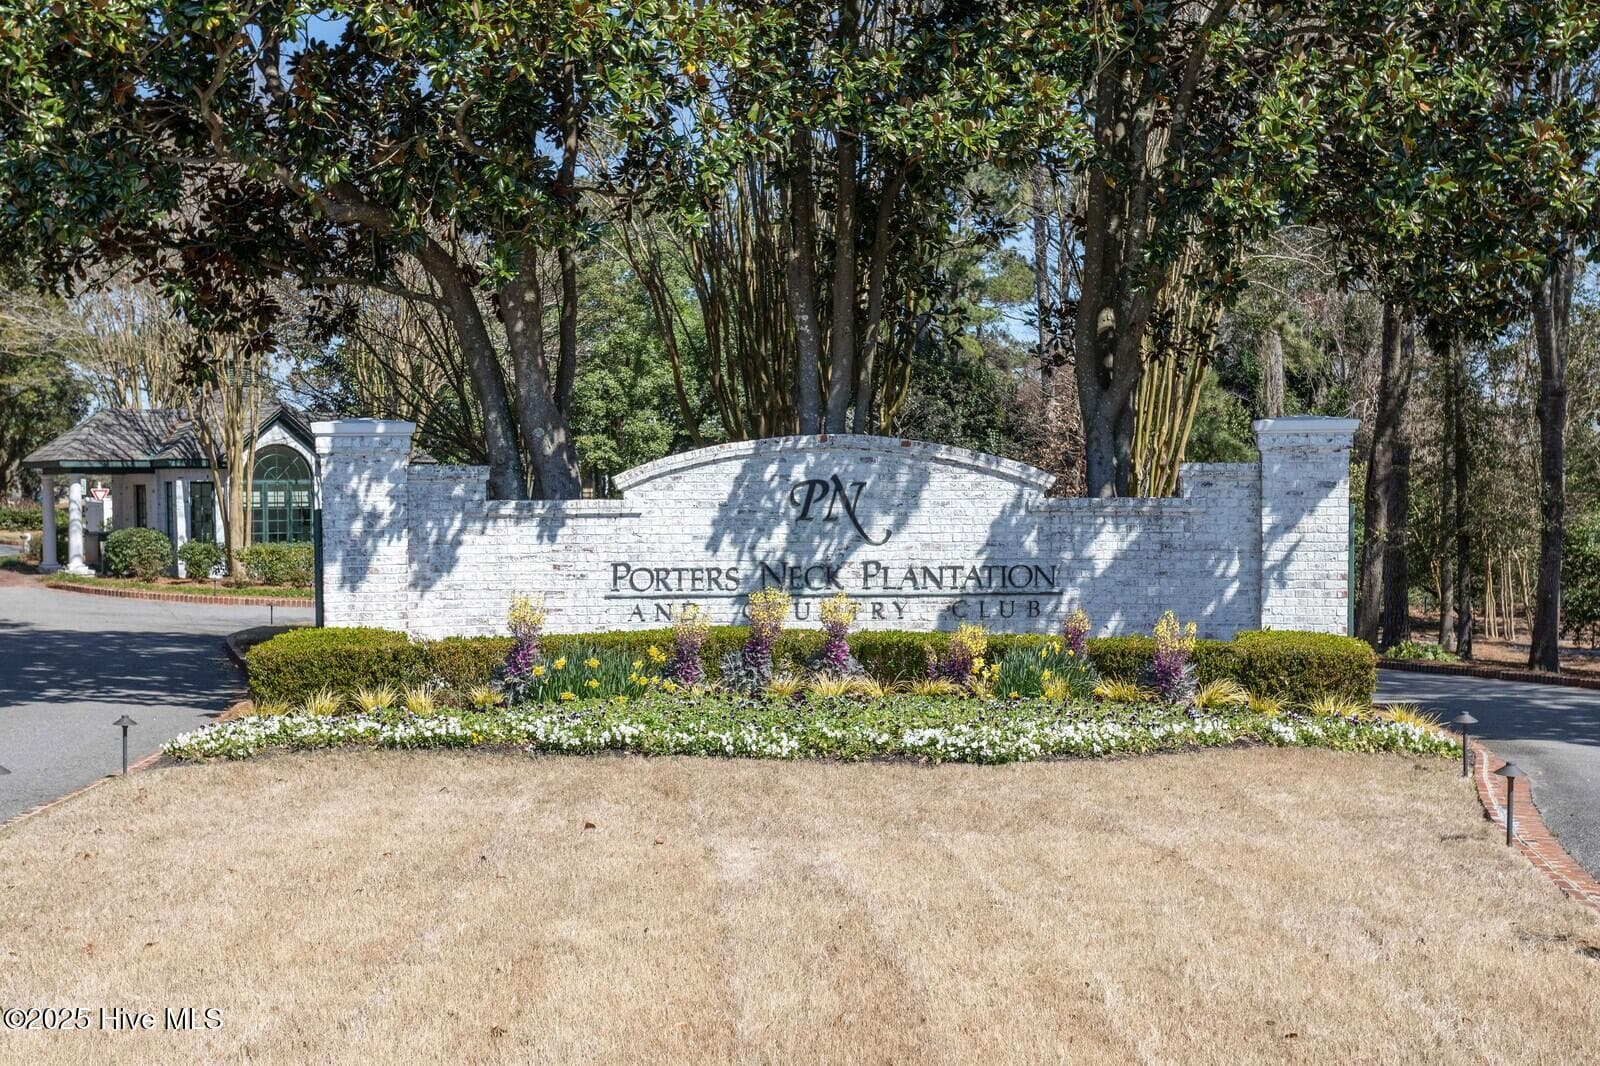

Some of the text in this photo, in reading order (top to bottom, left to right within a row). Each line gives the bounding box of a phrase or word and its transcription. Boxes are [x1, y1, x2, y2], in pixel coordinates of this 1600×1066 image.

[790, 474, 892, 546] PN
[610, 561, 1057, 592] PORTERS NECK PLANTATION
[950, 601, 1041, 620] CLUB
